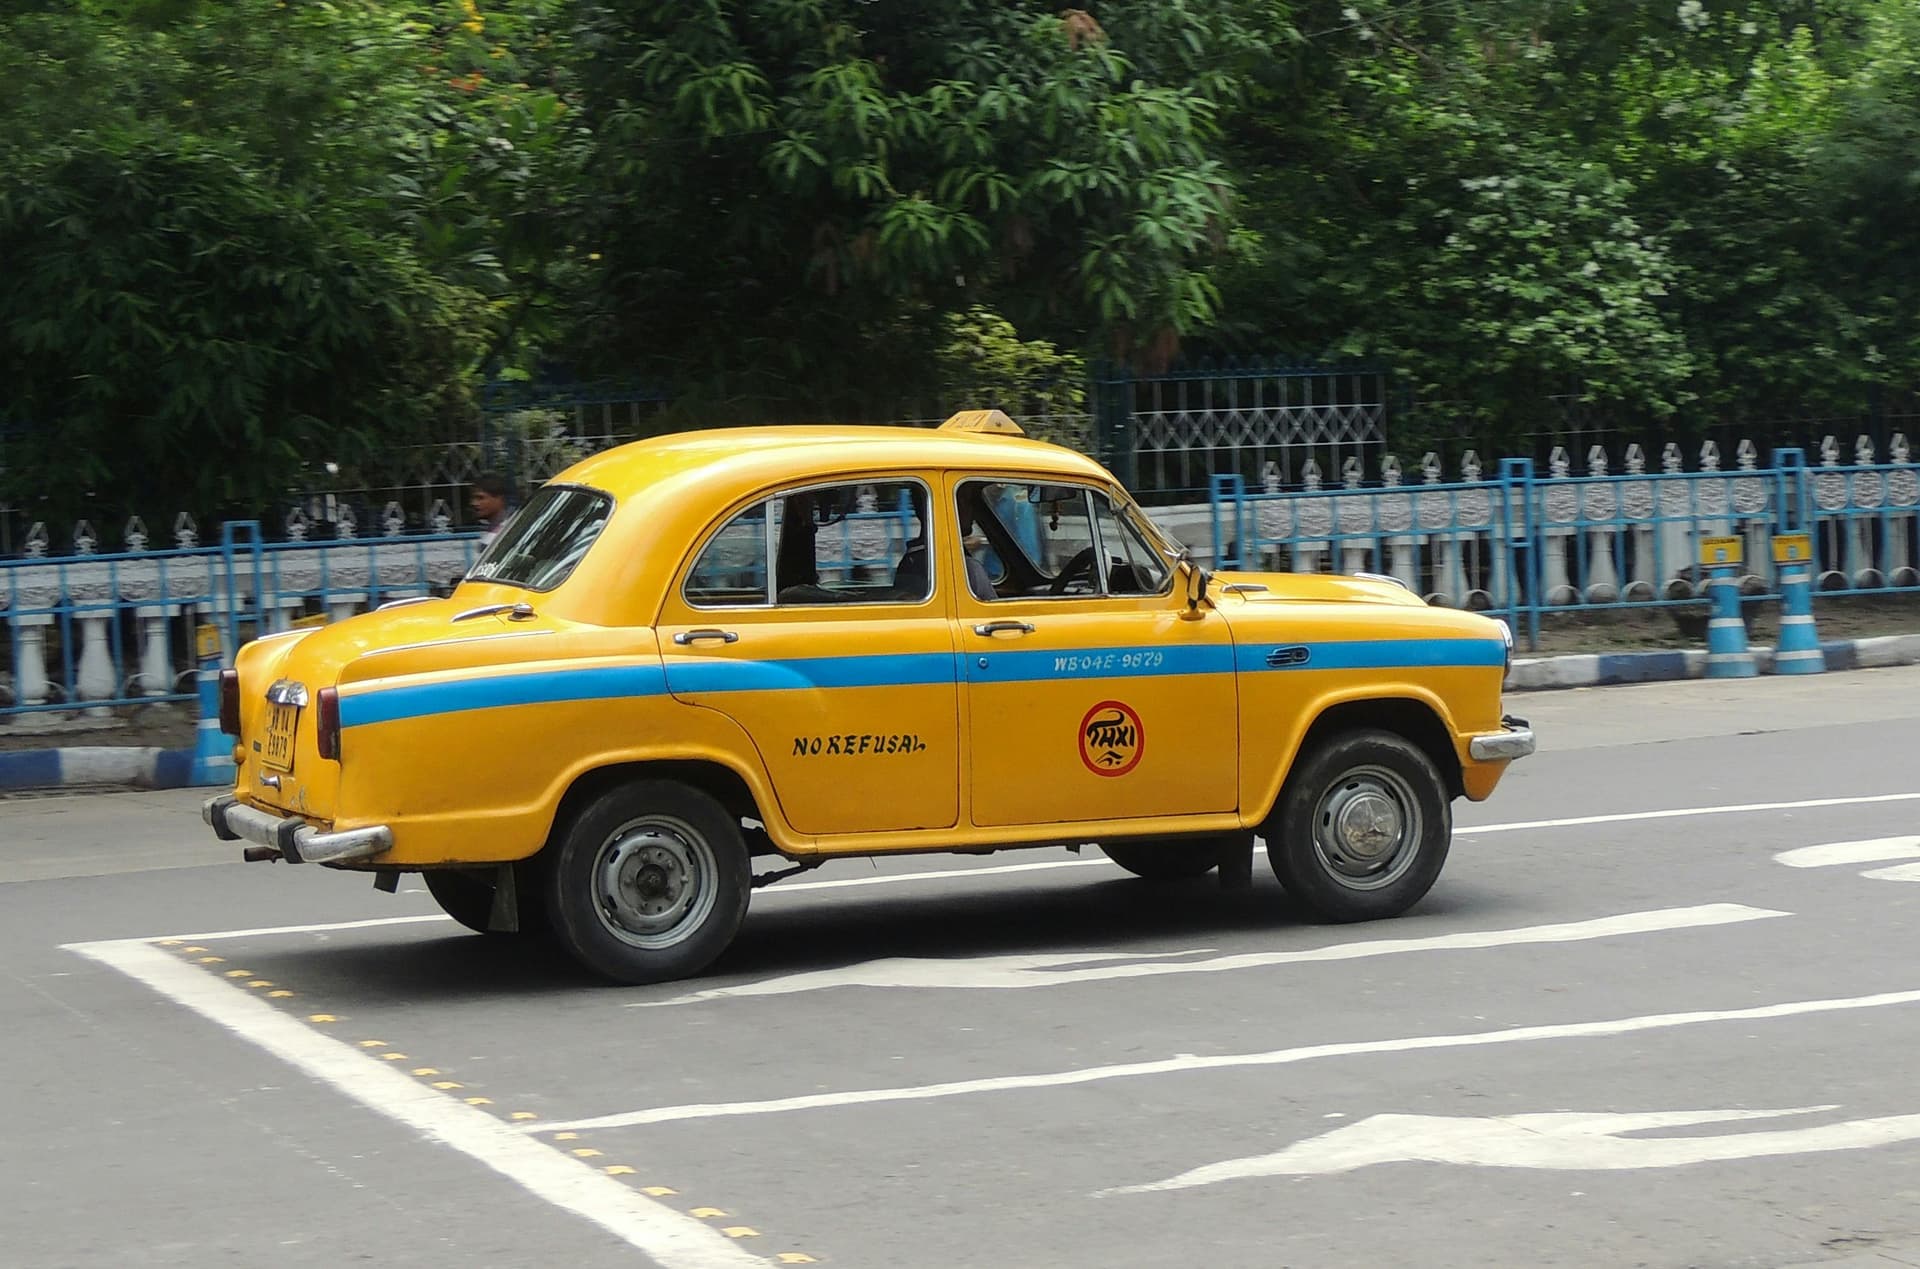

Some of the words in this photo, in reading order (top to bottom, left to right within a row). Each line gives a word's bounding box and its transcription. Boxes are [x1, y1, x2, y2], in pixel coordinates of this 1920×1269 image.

[1086, 710, 1135, 749] TAXI
[792, 737, 822, 756] NO
[826, 734, 926, 755] REFUSAL
